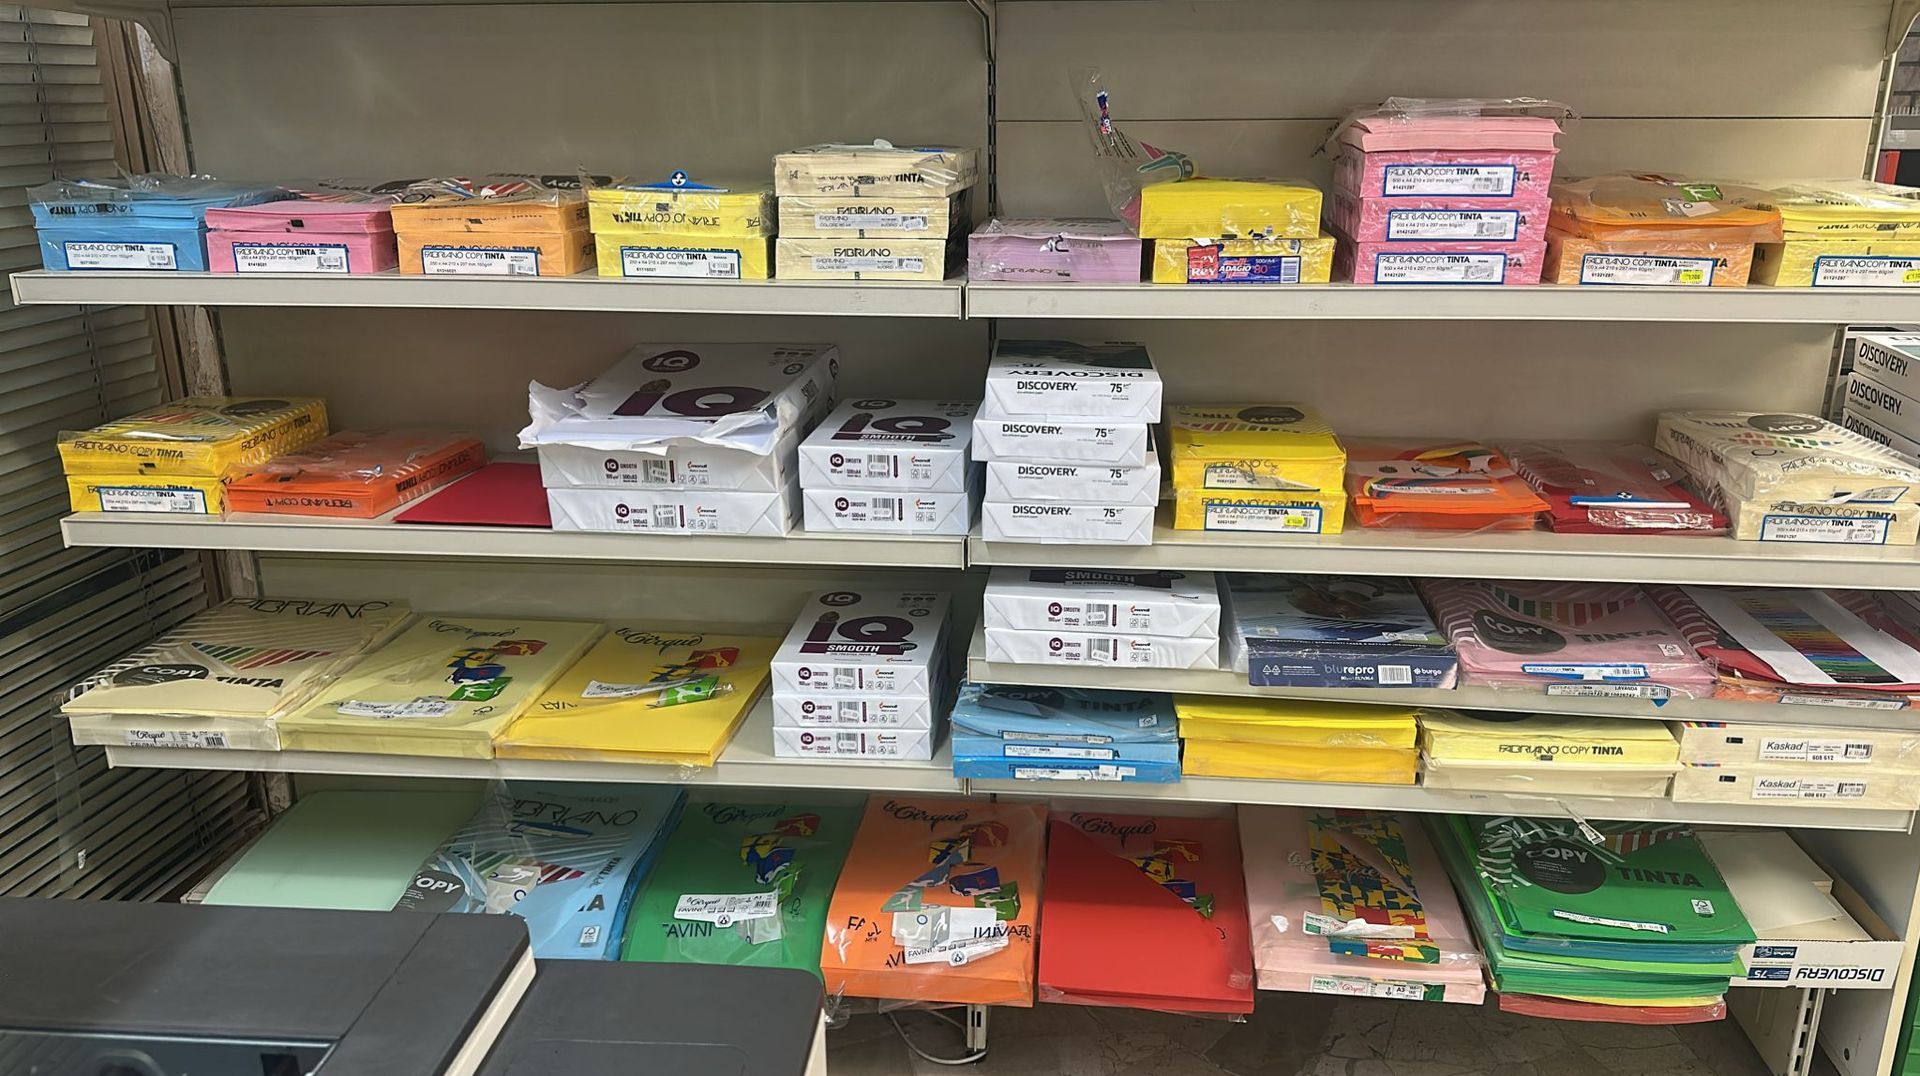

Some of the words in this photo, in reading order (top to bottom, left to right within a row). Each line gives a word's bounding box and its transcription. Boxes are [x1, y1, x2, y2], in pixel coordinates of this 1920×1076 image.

[1388, 168, 1433, 176] FABRIANO
[1434, 168, 1455, 176] COPY
[1456, 168, 1480, 176] TINTA
[895, 173, 925, 183] TINTA
[50, 204, 77, 214] TINTA
[837, 207, 895, 215] FABRIANO
[644, 213, 671, 223] COPY
[236, 248, 275, 256] FABRIANO
[424, 251, 464, 259] FABRIANO
[465, 251, 484, 259] COPY
[484, 252, 506, 260] TINTA
[625, 252, 664, 260] FABRIANO
[834, 248, 891, 257] FABRIANO
[1380, 255, 1425, 264] FABRIANO
[1425, 256, 1447, 264] COPY
[1585, 257, 1630, 266] FABRIANO
[1632, 258, 1654, 266] COPY
[1654, 259, 1678, 268] TINTA
[1820, 260, 1867, 268] FABRIANO
[1866, 260, 1888, 268] COPY
[1219, 265, 1251, 273] ADAGIO
[1255, 265, 1268, 274] 80
[1110, 383, 1123, 393] 75
[294, 413, 312, 429] TINTA
[1094, 428, 1107, 438] 75
[1768, 424, 1818, 433] COPY
[129, 445, 156, 457] COPY
[156, 448, 184, 459] TINTA
[1109, 469, 1122, 478] 75
[396, 475, 418, 492] TINTA
[273, 497, 299, 506] COPY
[301, 498, 353, 508] FABRIANO
[1103, 508, 1116, 518] 75
[1248, 507, 1267, 515] COPY
[1835, 508, 1865, 518] COPY
[1866, 511, 1897, 522] TINTA
[1767, 518, 1810, 526] FABRIANO
[1065, 571, 1135, 582] SMOOTH
[227, 598, 390, 619] FABRIANO
[1483, 615, 1544, 636] COPY
[1574, 628, 1669, 644] TINTA
[625, 630, 703, 656] Cirque
[1324, 664, 1375, 677] blurepro
[1421, 667, 1442, 678] burgo
[143, 666, 204, 678] COPY
[216, 676, 284, 688] TINTA
[1003, 691, 1052, 699] COPY
[1078, 699, 1154, 711] TINTA
[1499, 744, 1559, 754] FABRIANO
[1562, 745, 1590, 755] COPY
[1592, 746, 1623, 756] TINTA
[1766, 741, 1804, 751] Kaskad
[1759, 779, 1796, 788] Kaskad
[894, 806, 970, 832] Cirque
[1081, 817, 1157, 848] Cirque
[1525, 847, 1590, 864] COPY
[1616, 866, 1704, 888] TINTA
[908, 947, 933, 958] FAVINI
[1754, 970, 1768, 978] 75
[1795, 967, 1885, 982] DISCOVERY
